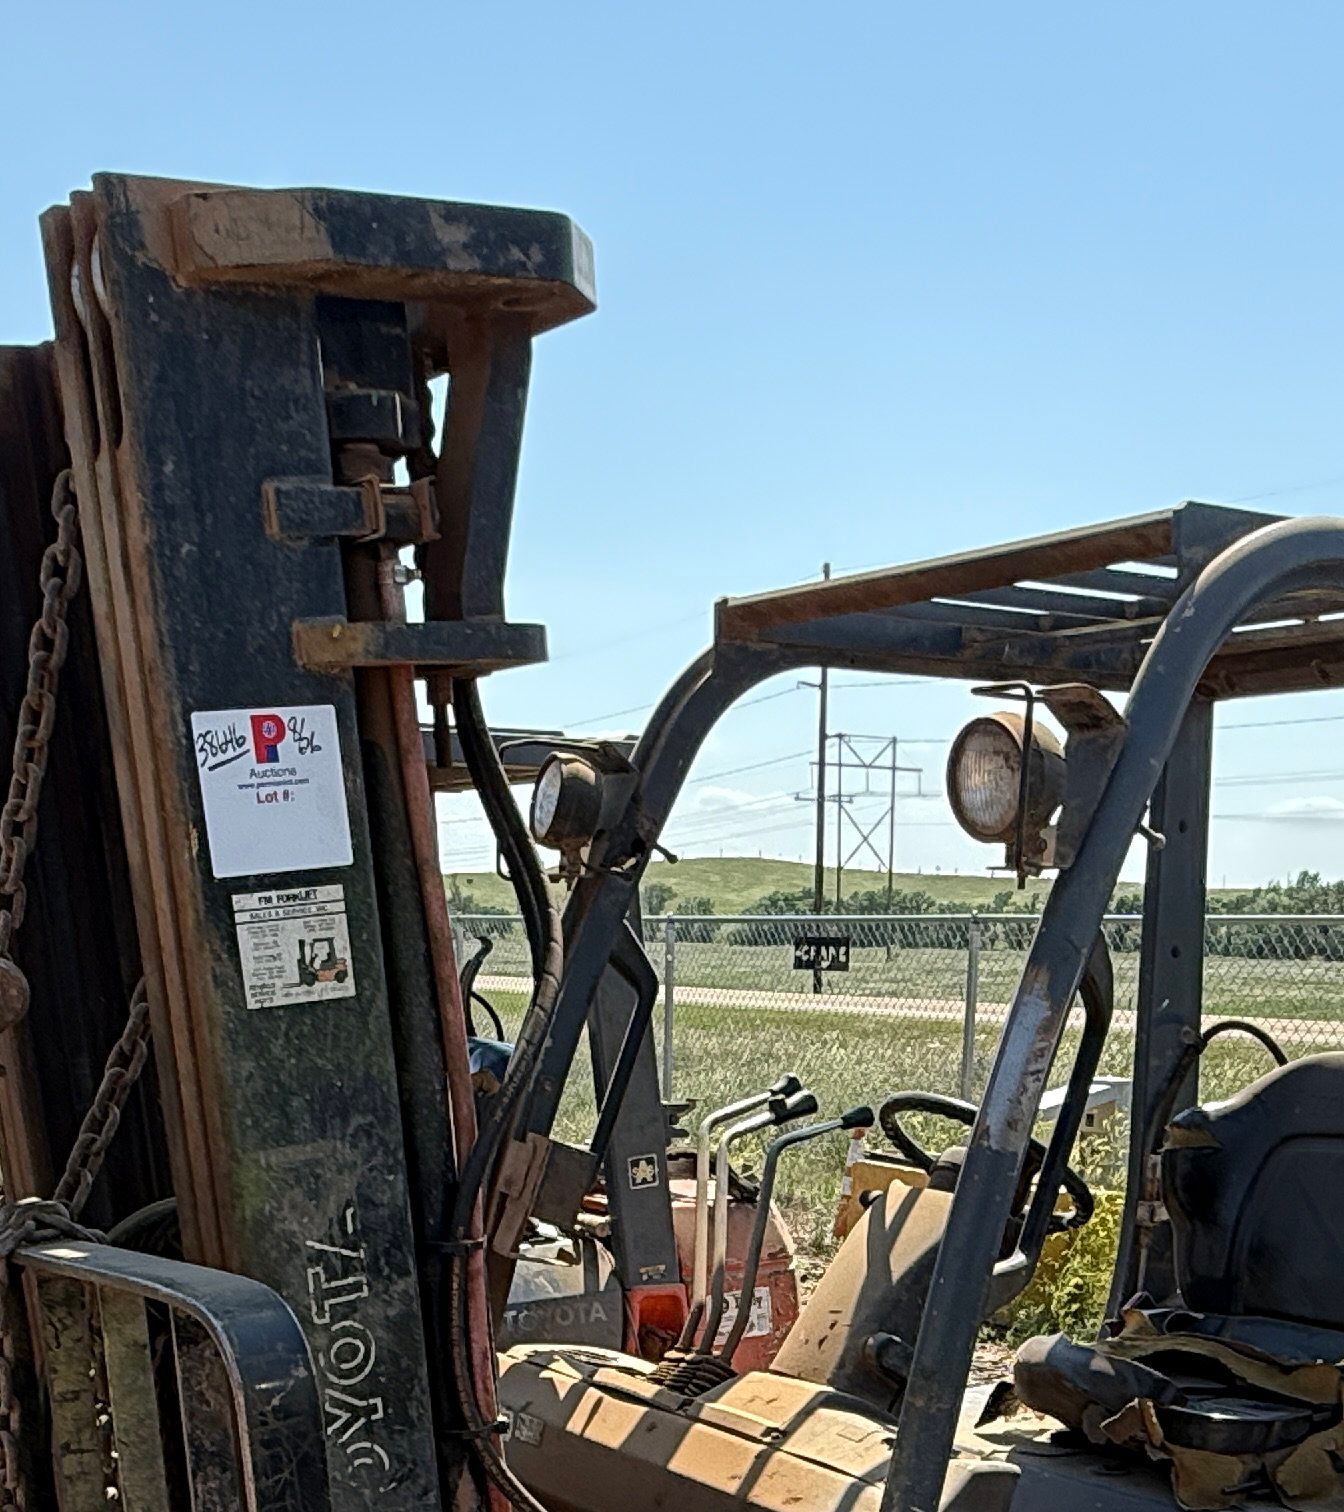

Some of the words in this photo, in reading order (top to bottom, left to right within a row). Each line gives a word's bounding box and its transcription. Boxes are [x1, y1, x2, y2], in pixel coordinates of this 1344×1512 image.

[249, 767, 297, 779] Auctions
[256, 790, 279, 804] Lot
[276, 889, 318, 904] FORKLIFT
